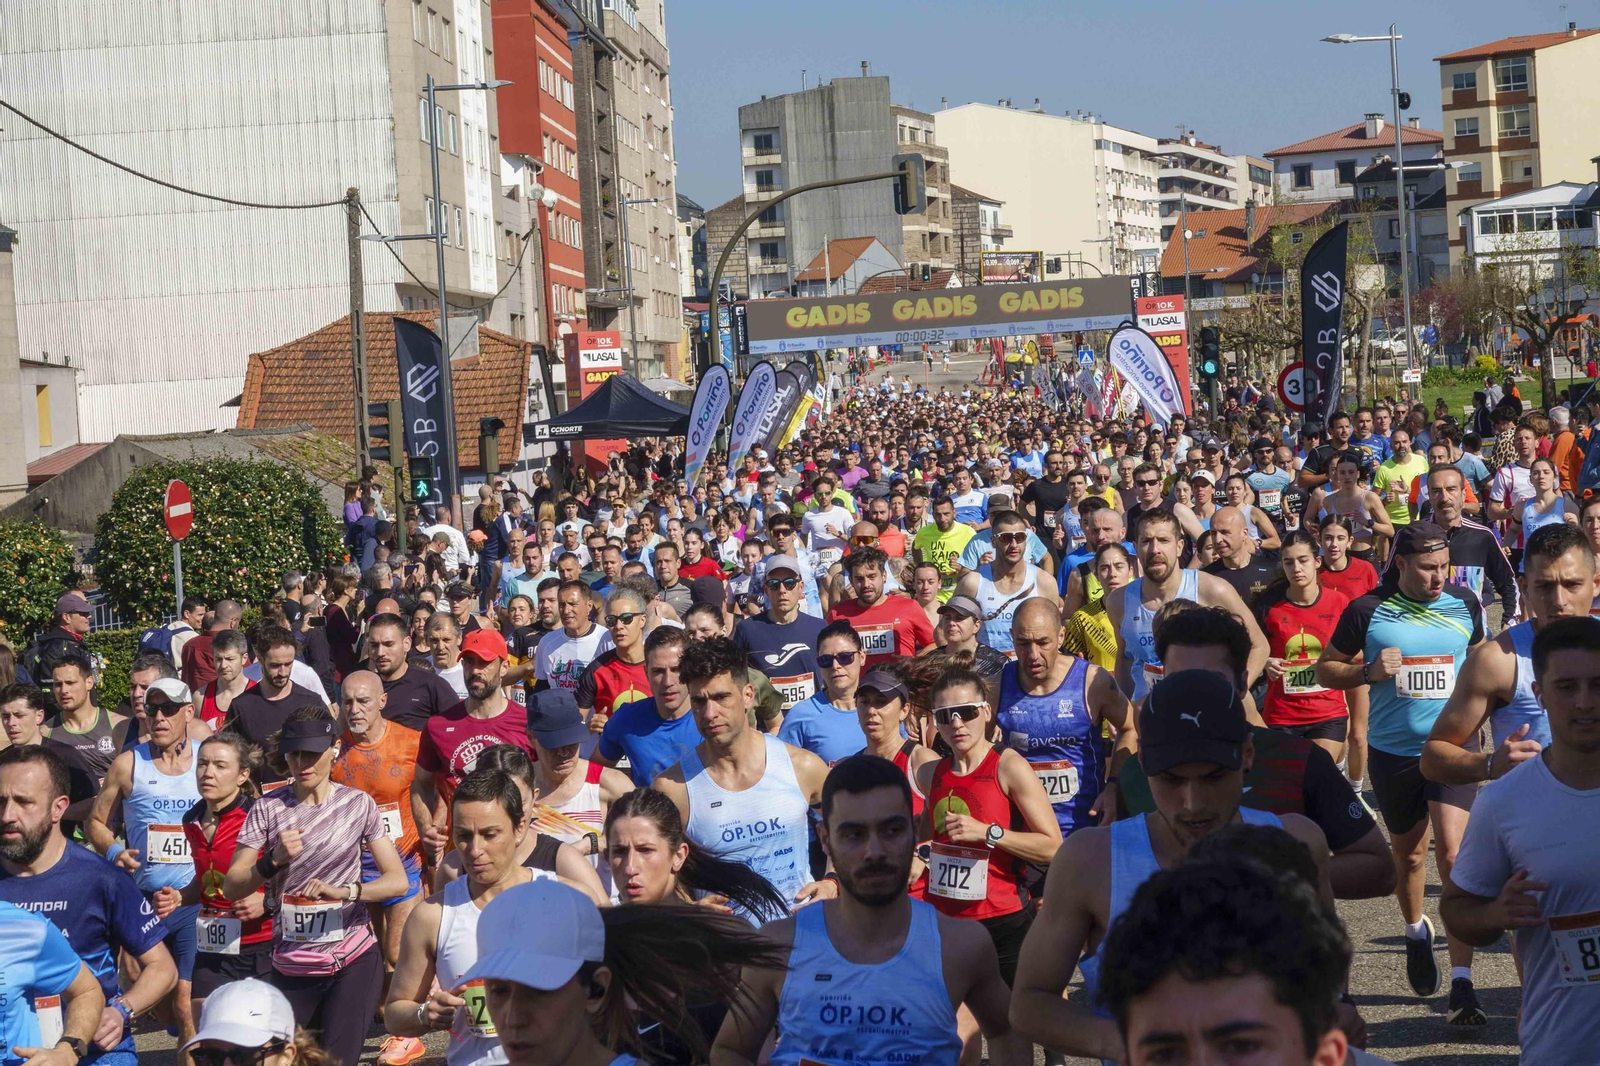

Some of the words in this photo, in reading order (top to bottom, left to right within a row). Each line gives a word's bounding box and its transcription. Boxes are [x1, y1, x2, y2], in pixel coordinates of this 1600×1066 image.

[892, 294, 978, 320] GADIS
[999, 287, 1084, 314] GADIS
[786, 302, 872, 328] GADIS
[1151, 316, 1181, 326] LASAL
[896, 330, 944, 342] 00:00:32
[592, 352, 618, 362] LASAL
[758, 385, 792, 436] LASAL
[550, 426, 583, 434] CCNORTE
[931, 541, 946, 550] UN
[861, 634, 887, 650] 1056
[1290, 670, 1316, 687] 202
[1408, 670, 1446, 690] 1006
[452, 737, 474, 758] CONCELLO
[162, 838, 188, 856] 451
[774, 846, 794, 857] GADIS
[938, 862, 971, 890] 202
[294, 912, 328, 934] 977
[206, 924, 226, 944] 198
[887, 1052, 921, 1062] GADIS
